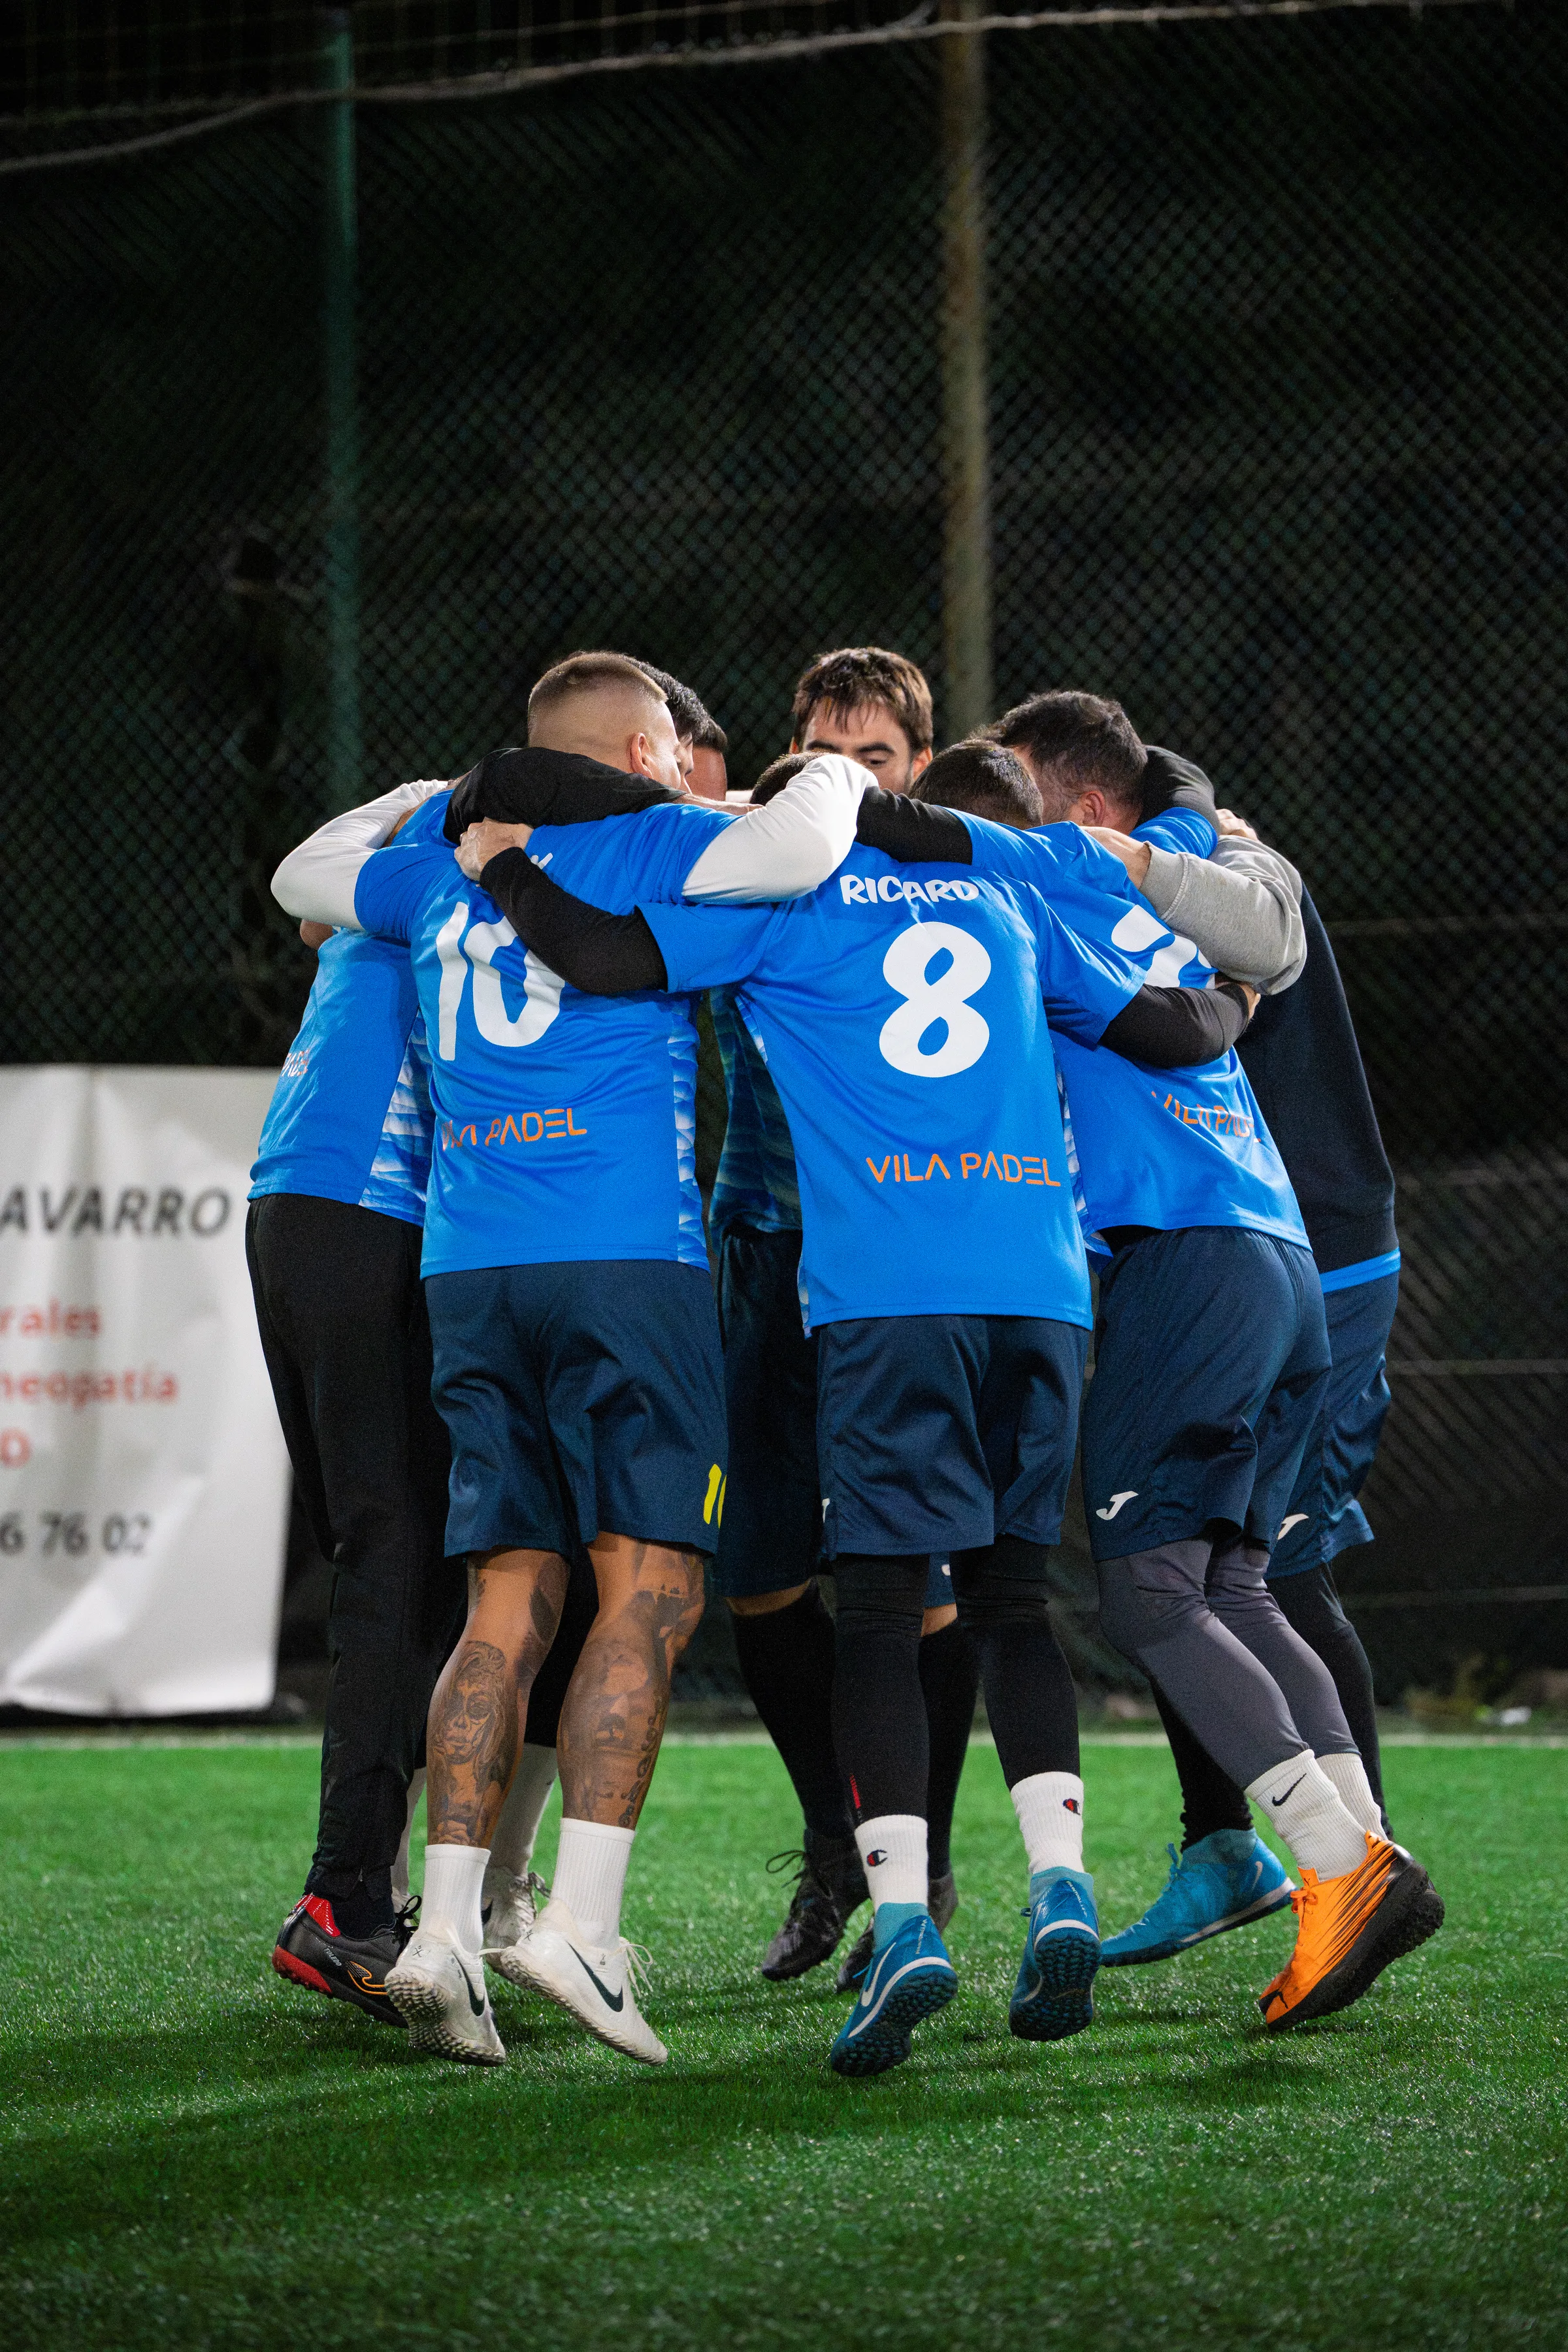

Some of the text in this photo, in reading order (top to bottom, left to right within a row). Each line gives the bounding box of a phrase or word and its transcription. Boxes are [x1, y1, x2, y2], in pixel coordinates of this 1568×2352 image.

[840, 874, 979, 905] RICARD
[436, 902, 565, 1061] 10
[879, 921, 991, 1077] 8
[485, 1108, 587, 1147] PADEL
[866, 1151, 1061, 1187] VILA PADEL
[703, 1463, 727, 1529] 1
[324, 1948, 342, 1967] TOLEDO
